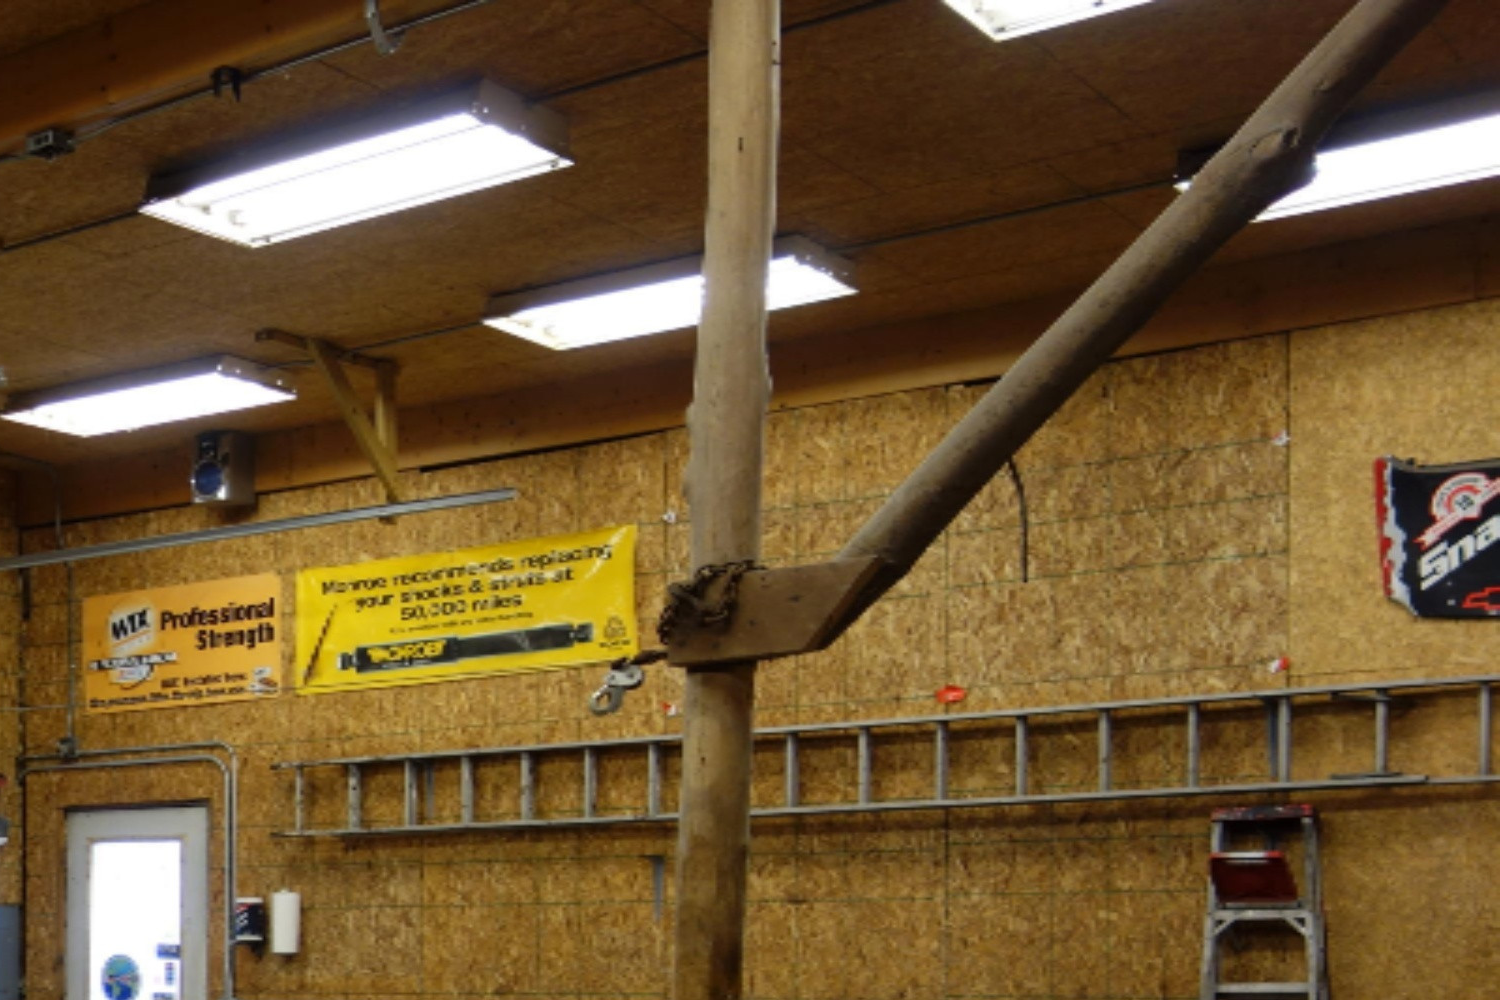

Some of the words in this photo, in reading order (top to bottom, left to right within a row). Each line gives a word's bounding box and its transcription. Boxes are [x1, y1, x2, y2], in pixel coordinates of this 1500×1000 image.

[393, 557, 514, 585] recommends
[520, 544, 612, 569] replacing
[356, 594, 394, 613] your
[401, 583, 464, 603] shocks
[468, 580, 483, 593] &
[551, 568, 574, 583] at
[472, 595, 523, 612] miles
[161, 597, 275, 630] Professional
[196, 623, 275, 650] Strength
